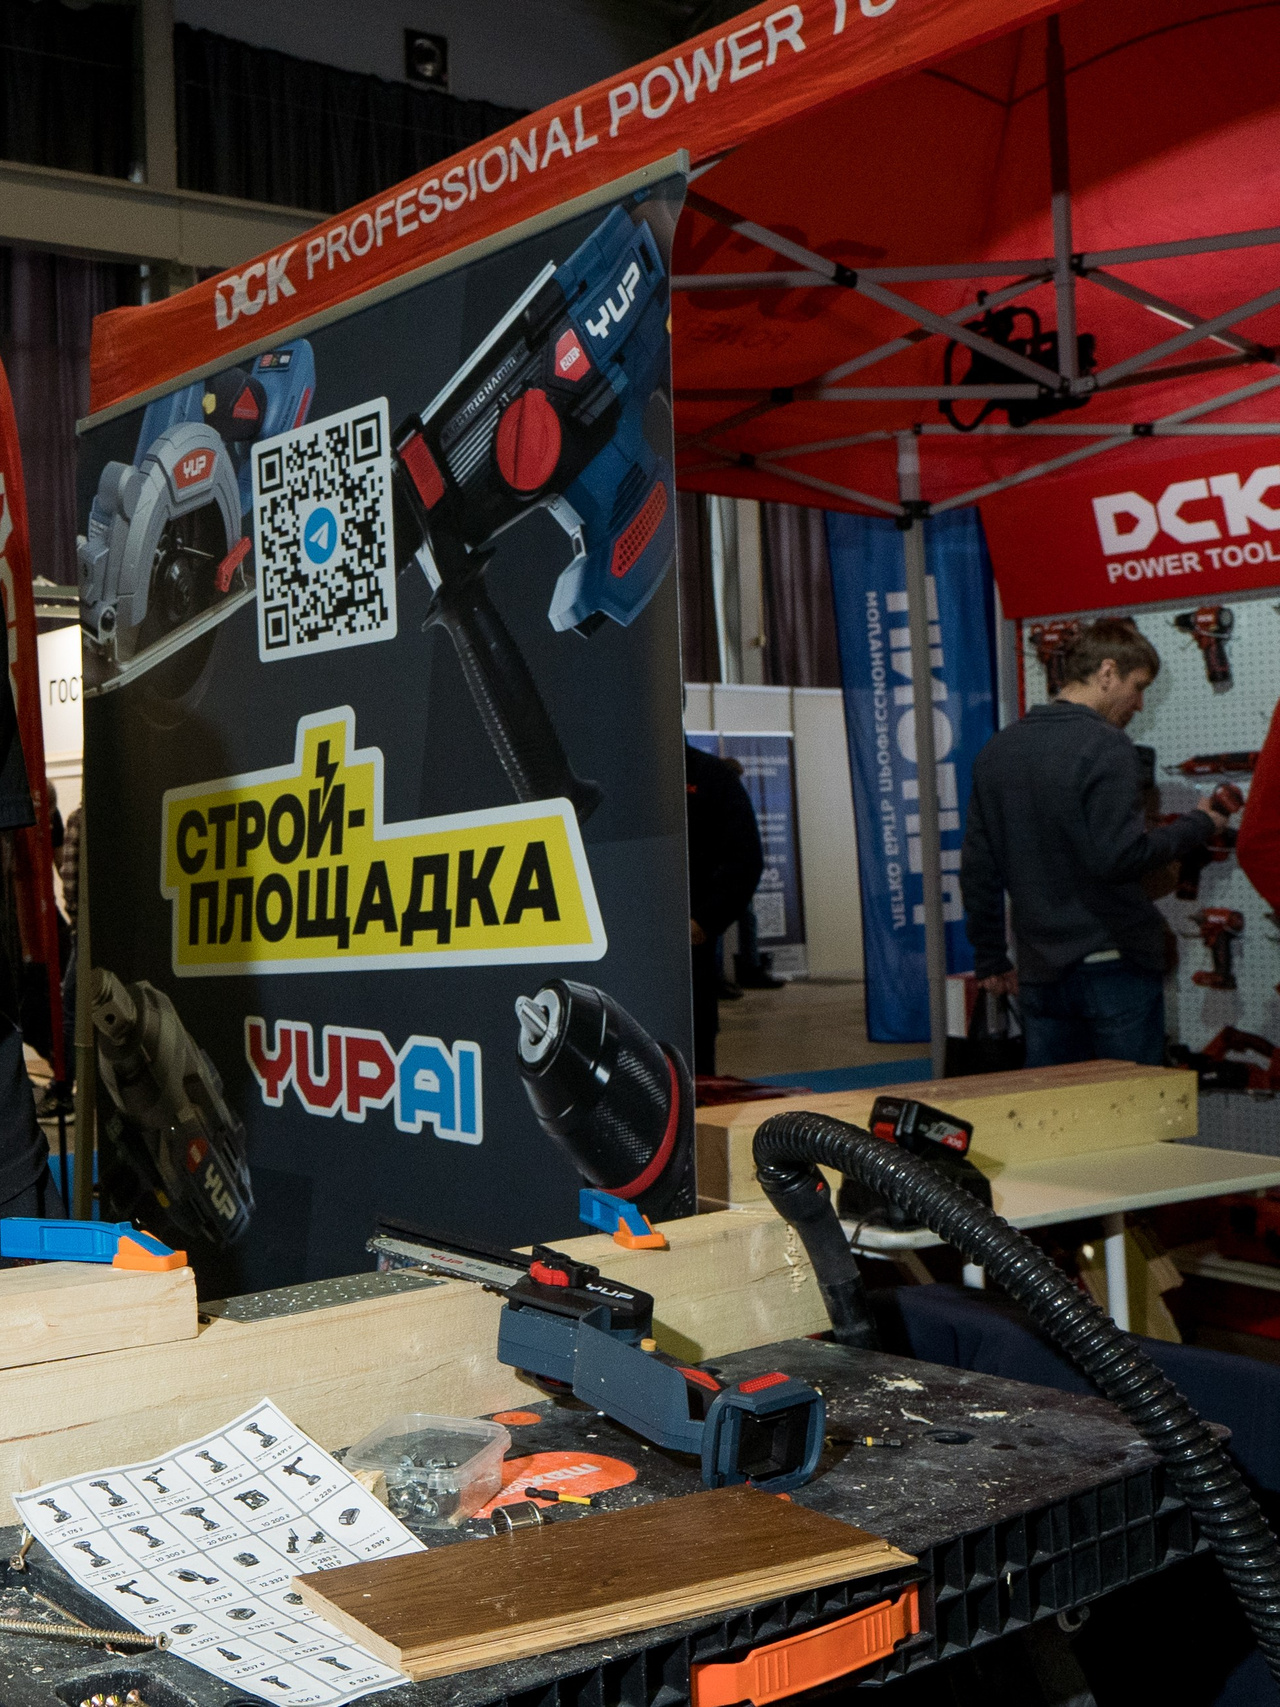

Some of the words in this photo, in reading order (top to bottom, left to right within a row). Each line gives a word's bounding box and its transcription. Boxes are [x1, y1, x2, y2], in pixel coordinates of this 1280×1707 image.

[215, 244, 298, 330] DCK
[306, 105, 599, 280] PROFESSIONAL
[608, 4, 807, 138] POWER
[585, 262, 640, 339] YUP
[183, 455, 207, 479] YUP
[1092, 464, 1280, 556] DCK
[1106, 551, 1203, 584] POWER
[50, 676, 82, 706] ГОС
[176, 752, 366, 875] СТРОЙ-
[188, 840, 561, 950] ПЛОЩАДКА
[247, 1020, 479, 1139] YUPAI
[204, 1163, 237, 1220] YUP
[586, 1283, 634, 1300] YUP
